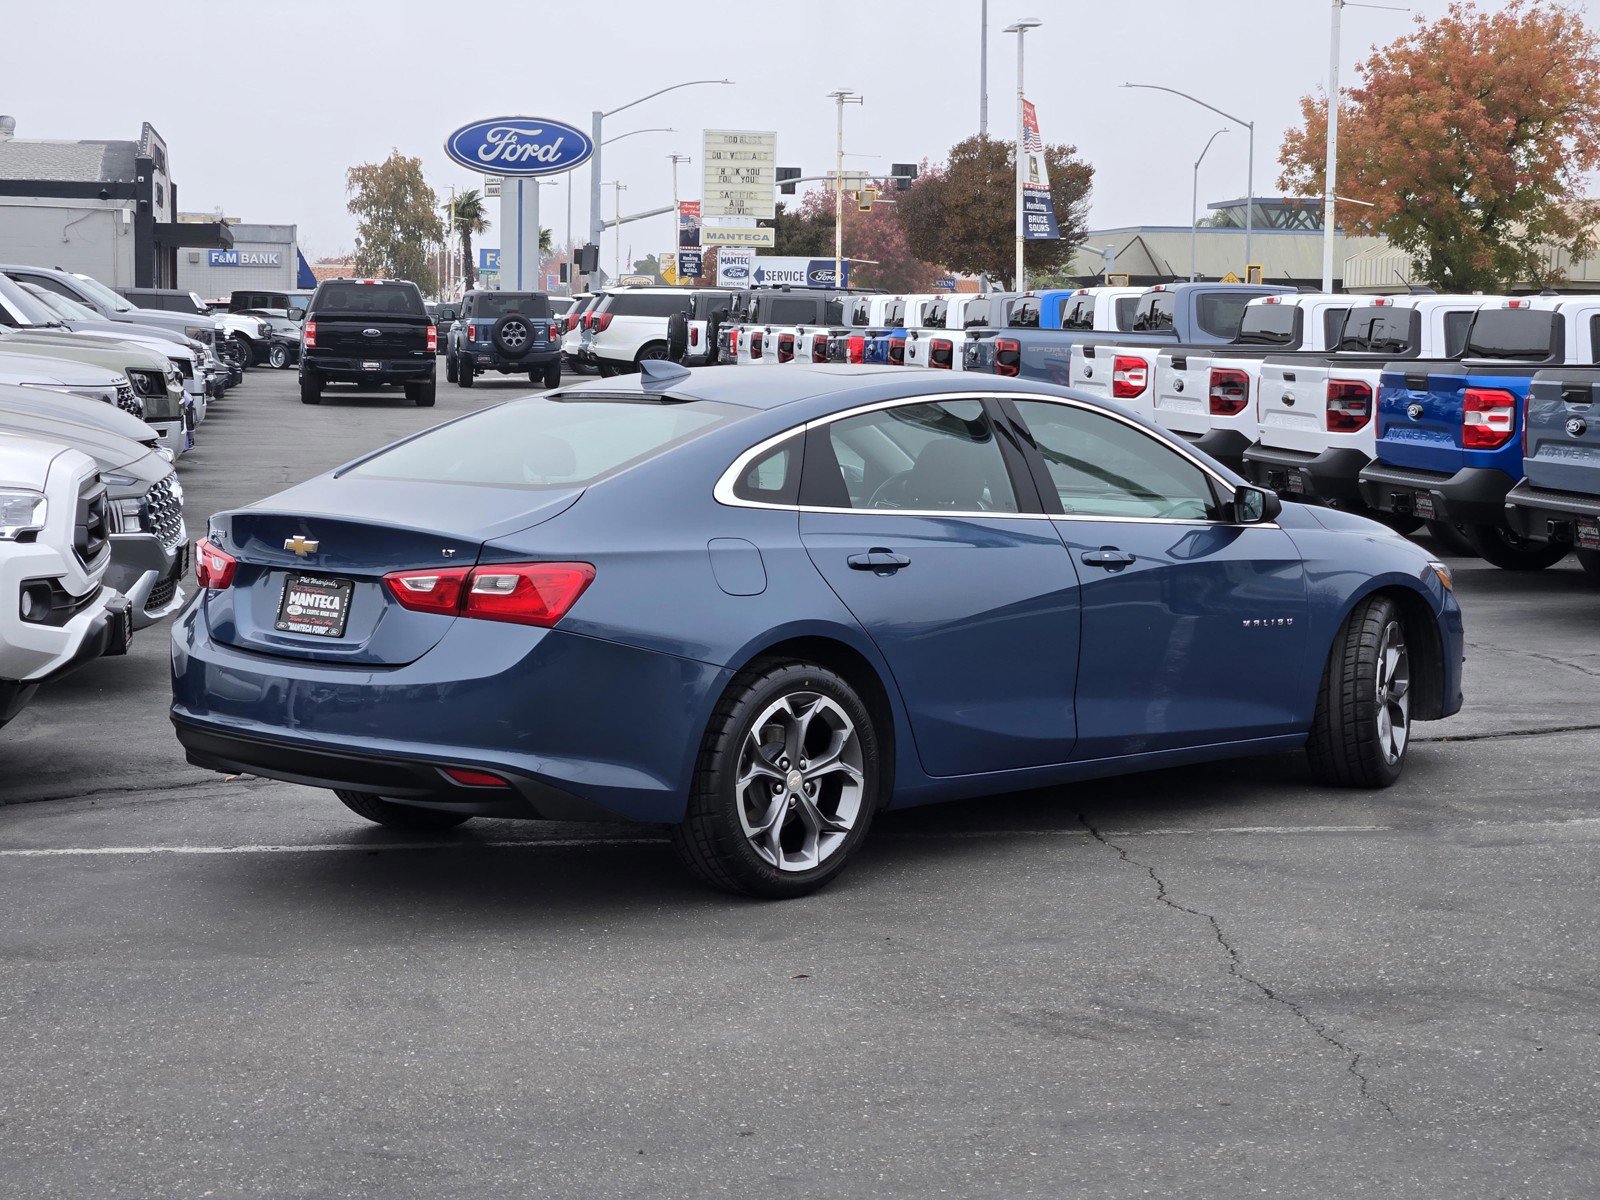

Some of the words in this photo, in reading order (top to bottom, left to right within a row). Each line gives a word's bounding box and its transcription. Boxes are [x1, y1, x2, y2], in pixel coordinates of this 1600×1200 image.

[477, 126, 565, 162] Ford
[1028, 215, 1048, 224] BRUCE
[1028, 223, 1050, 232] SOURS
[706, 233, 770, 241] MANTECA
[211, 253, 237, 264] F&M
[241, 253, 278, 264] BANK
[720, 256, 749, 265] MANTEC
[727, 268, 746, 277] Ford
[765, 270, 804, 282] SERVICE
[1578, 526, 1599, 535] MANTECA
[441, 548, 456, 558] LT
[289, 592, 339, 609] MANTECA
[1242, 617, 1294, 627] MALIBU
